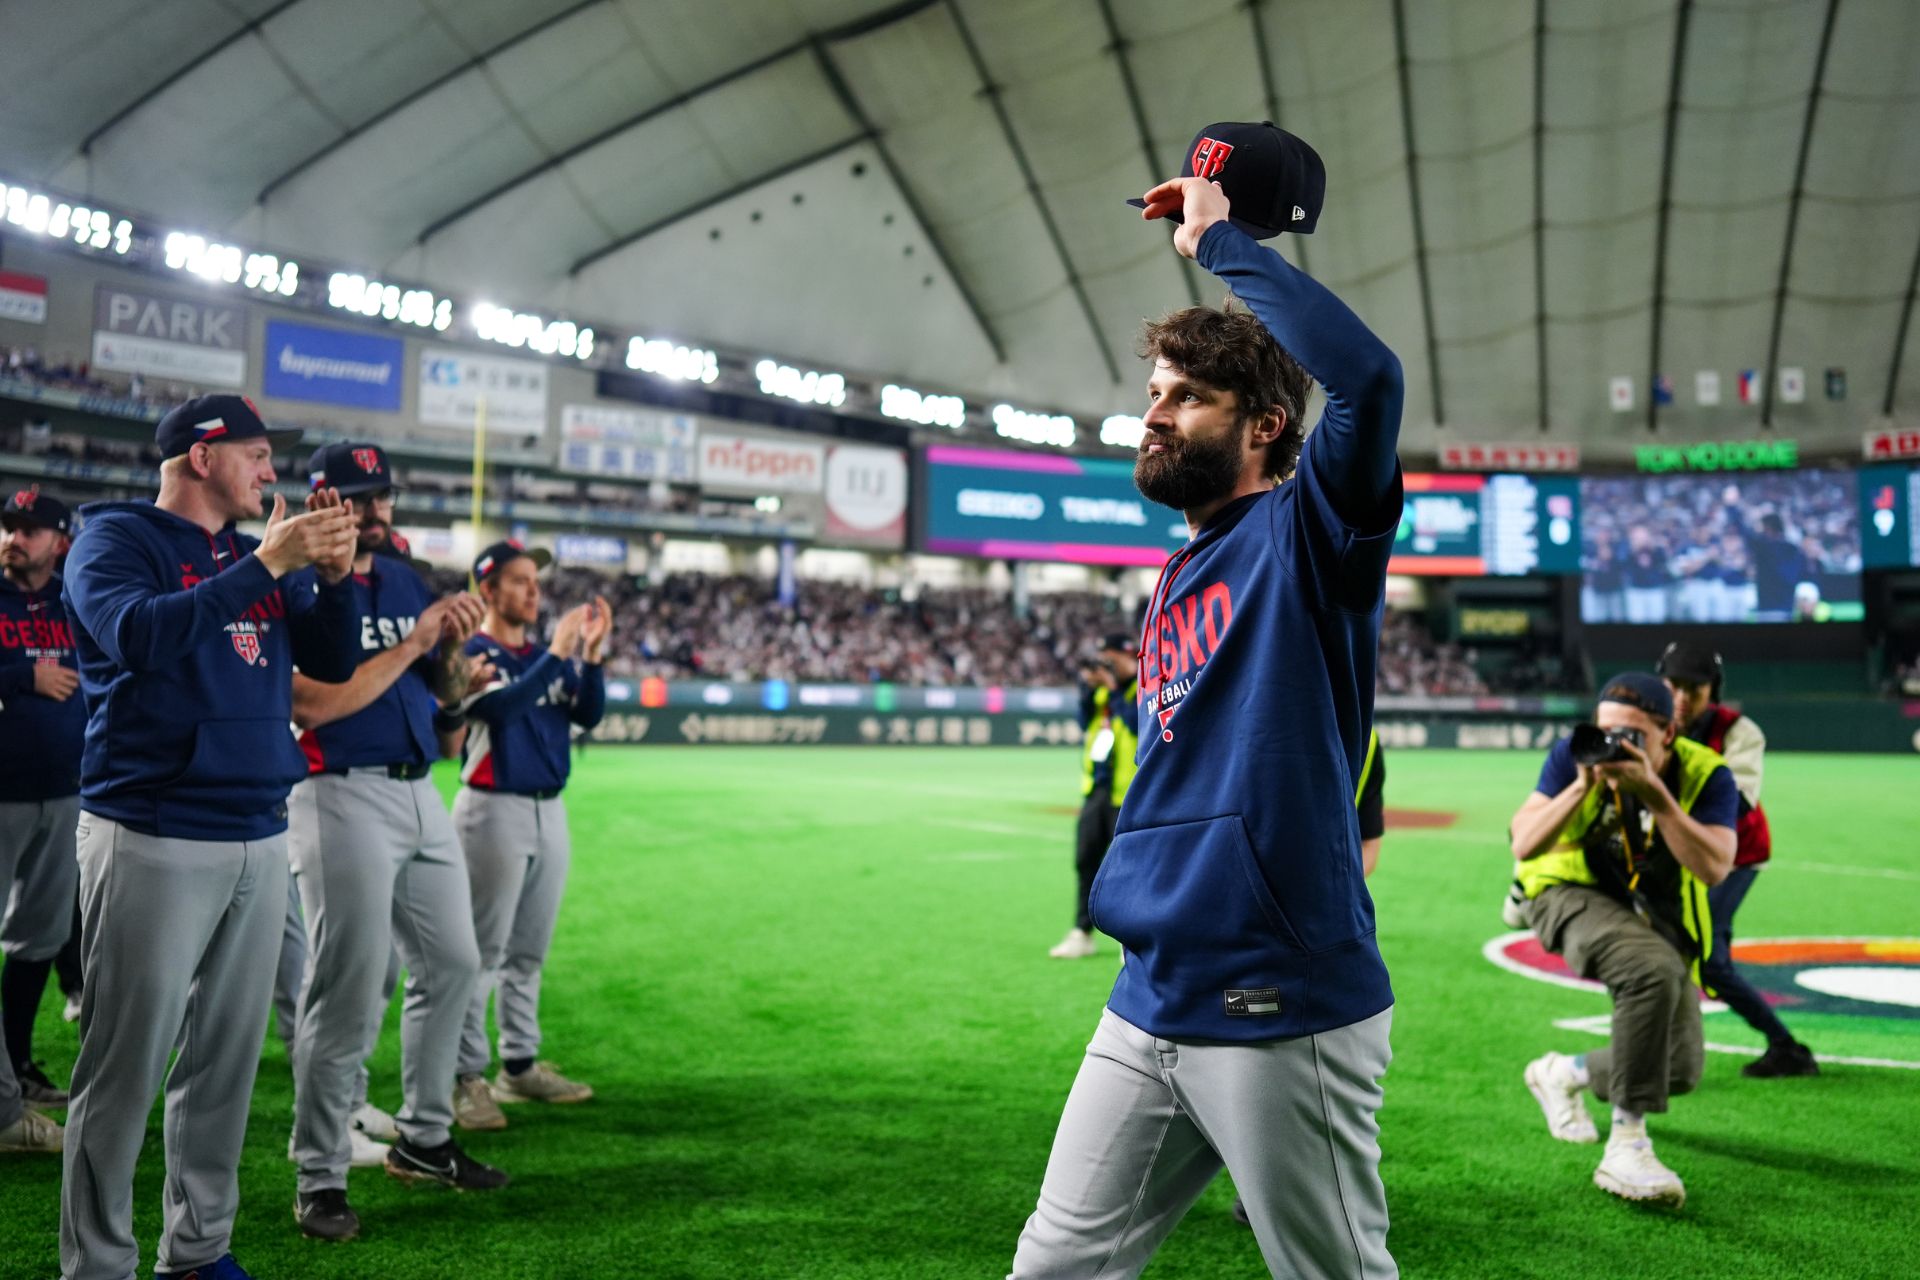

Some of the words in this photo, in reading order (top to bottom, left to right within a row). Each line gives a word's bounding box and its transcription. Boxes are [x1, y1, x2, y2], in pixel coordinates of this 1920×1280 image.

[109, 292, 232, 349] PARK
[707, 439, 816, 478] nippn
[1635, 441, 1720, 473] TOKYO
[1722, 438, 1798, 470] DOME
[1137, 580, 1233, 707] ESKO
